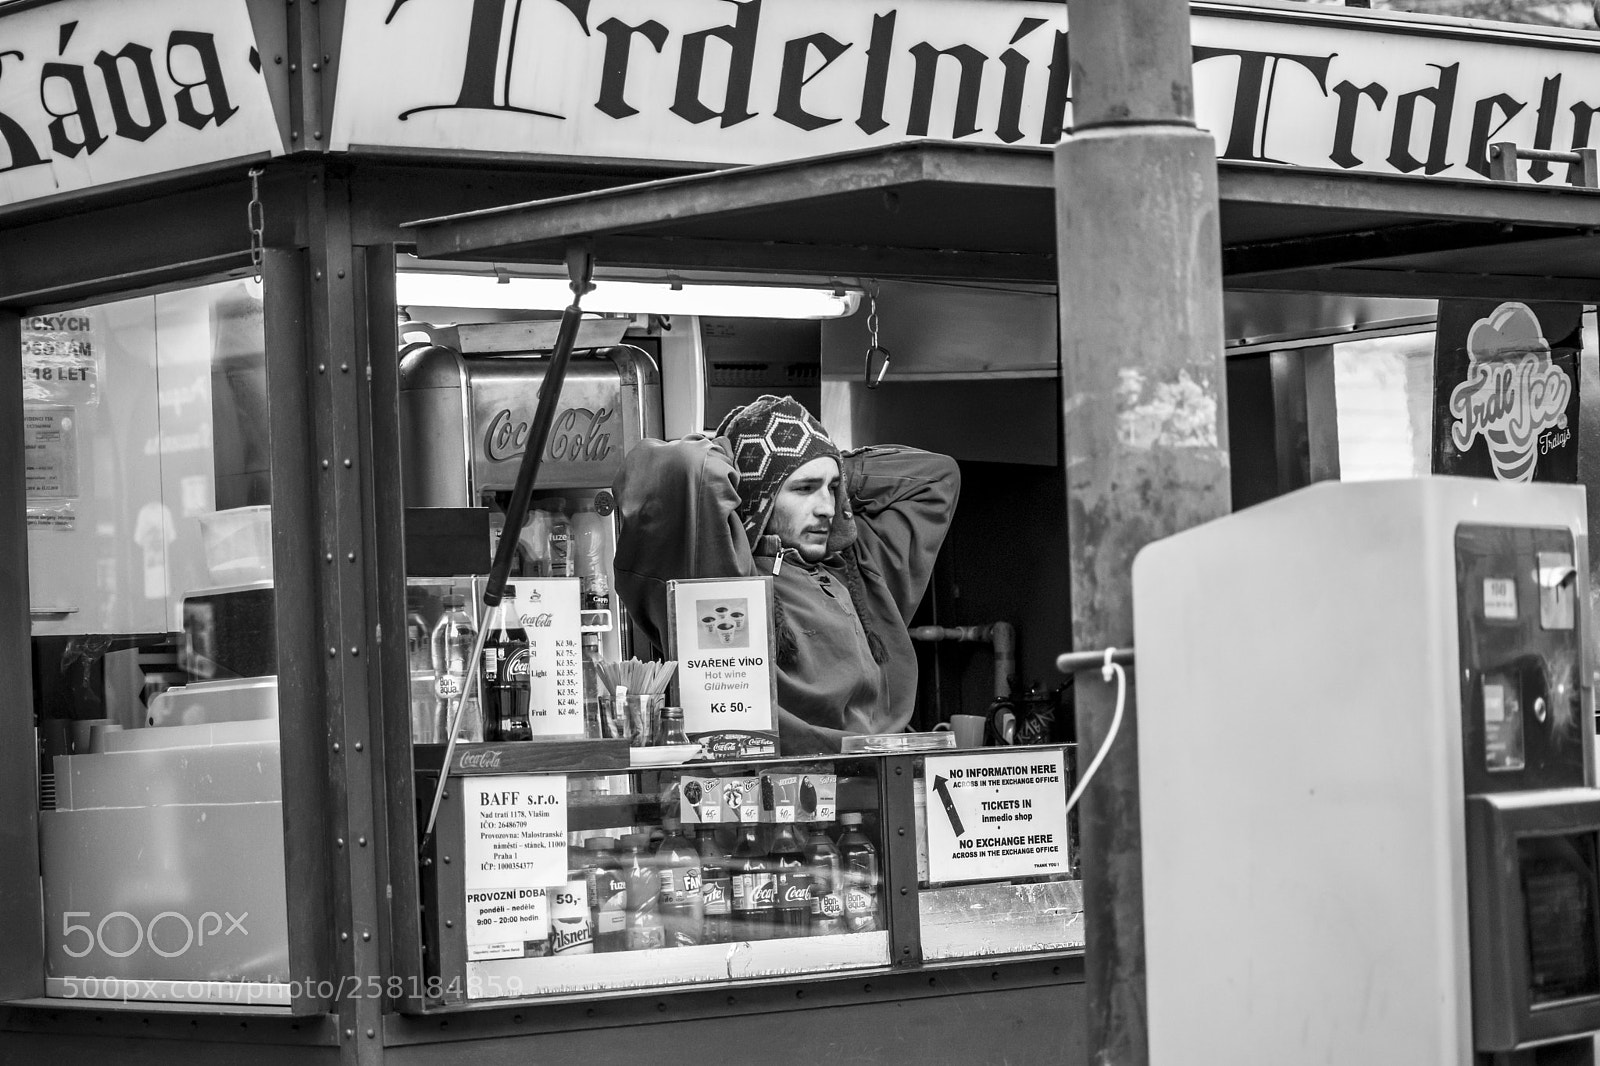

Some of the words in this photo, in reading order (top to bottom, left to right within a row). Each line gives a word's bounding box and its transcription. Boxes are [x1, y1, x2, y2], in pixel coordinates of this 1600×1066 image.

[59, 367, 89, 381] LET
[687, 657, 736, 669] SVAŘENÉ
[738, 656, 763, 667] VÍNO
[532, 670, 547, 678] Light
[705, 671, 721, 679] Hot
[725, 670, 746, 678] wine
[704, 682, 749, 691] Glühwein
[711, 703, 726, 713] Kč
[730, 702, 752, 713] 50,-
[950, 769, 963, 778] NO
[967, 766, 1028, 777] INFORMATION
[1031, 764, 1056, 774] HERE
[1002, 777, 1034, 785] EXCHANGE
[480, 792, 520, 806] BAFF
[528, 795, 558, 805] s.r.o.
[982, 800, 1020, 810] TICKETS
[1022, 799, 1032, 808] IN
[1015, 813, 1032, 822] shop
[480, 821, 497, 829] IČO:
[960, 840, 973, 849] NO
[976, 836, 1025, 847] EXCHANGE
[1028, 834, 1053, 844] HERE
[1002, 848, 1034, 856] EXCHANGE
[481, 862, 496, 870] IČP:
[683, 875, 701, 891] FAN
[467, 889, 516, 903] PROVOZNÍ
[520, 889, 546, 898] DOBA
[499, 916, 518, 924] 20:00
